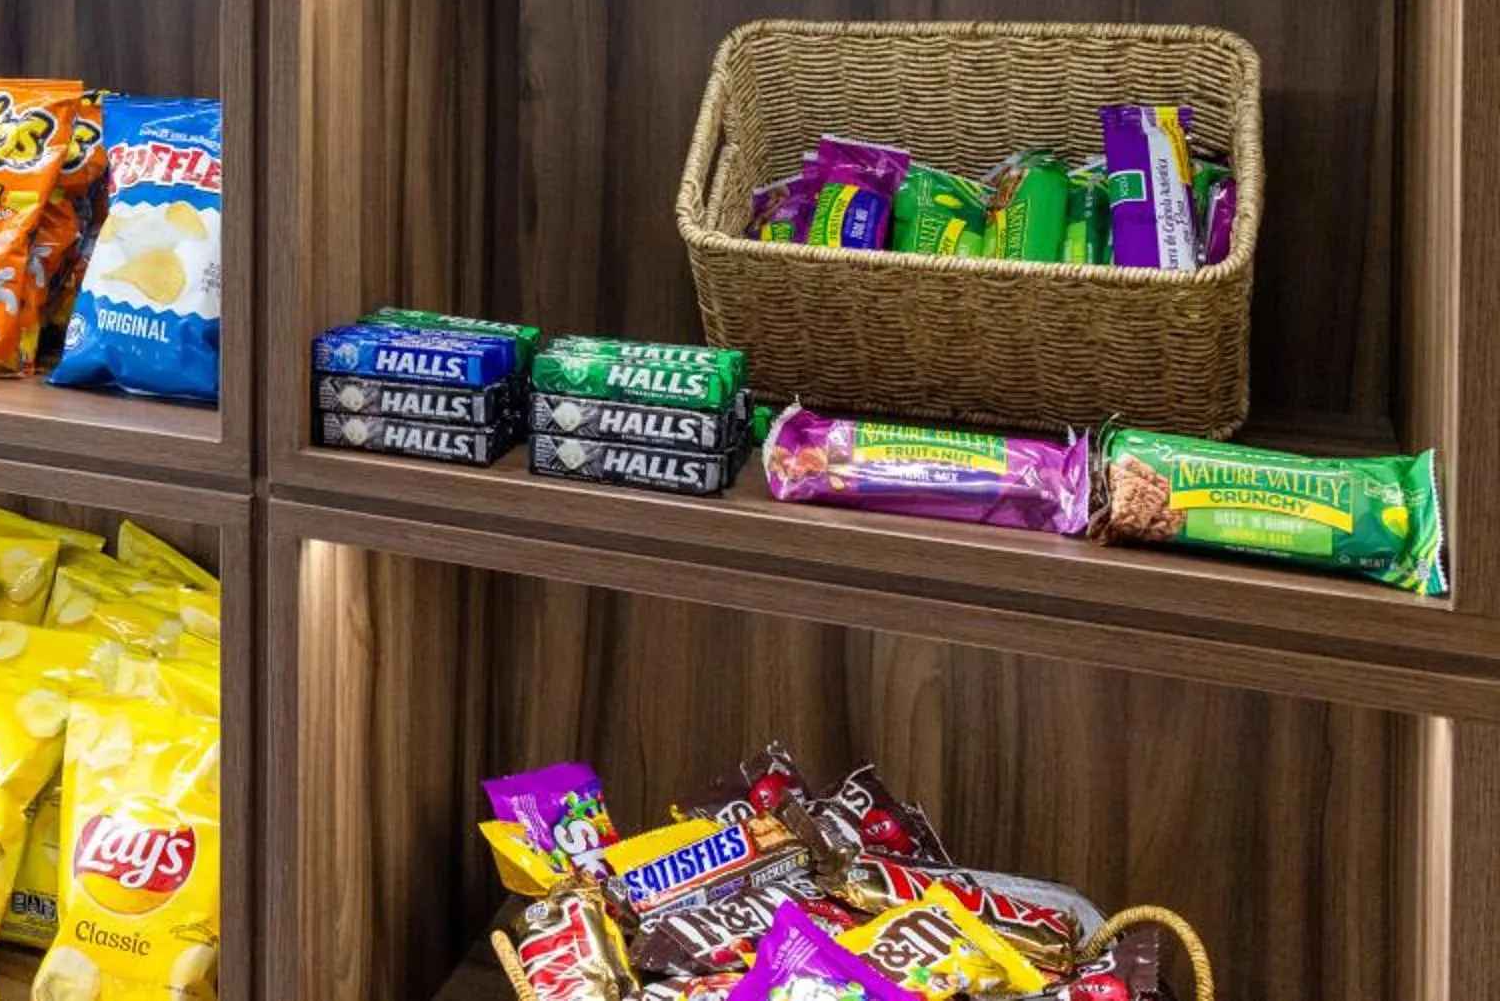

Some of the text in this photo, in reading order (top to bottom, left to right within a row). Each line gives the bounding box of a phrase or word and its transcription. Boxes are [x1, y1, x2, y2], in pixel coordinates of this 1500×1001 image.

[98, 308, 170, 343] ORIGINAL
[376, 350, 463, 379] HALLS
[607, 365, 706, 397] HALLS
[381, 390, 468, 419] HALLS
[384, 426, 470, 455] HALLS
[600, 409, 698, 441] HALLS
[604, 449, 701, 485] HALLS
[1179, 460, 1346, 508] NATURE VALLEY
[1209, 490, 1309, 514] CRUNCHY
[77, 816, 191, 890] Lay's
[625, 825, 747, 901] SATISFIES
[75, 920, 151, 956] Classic
